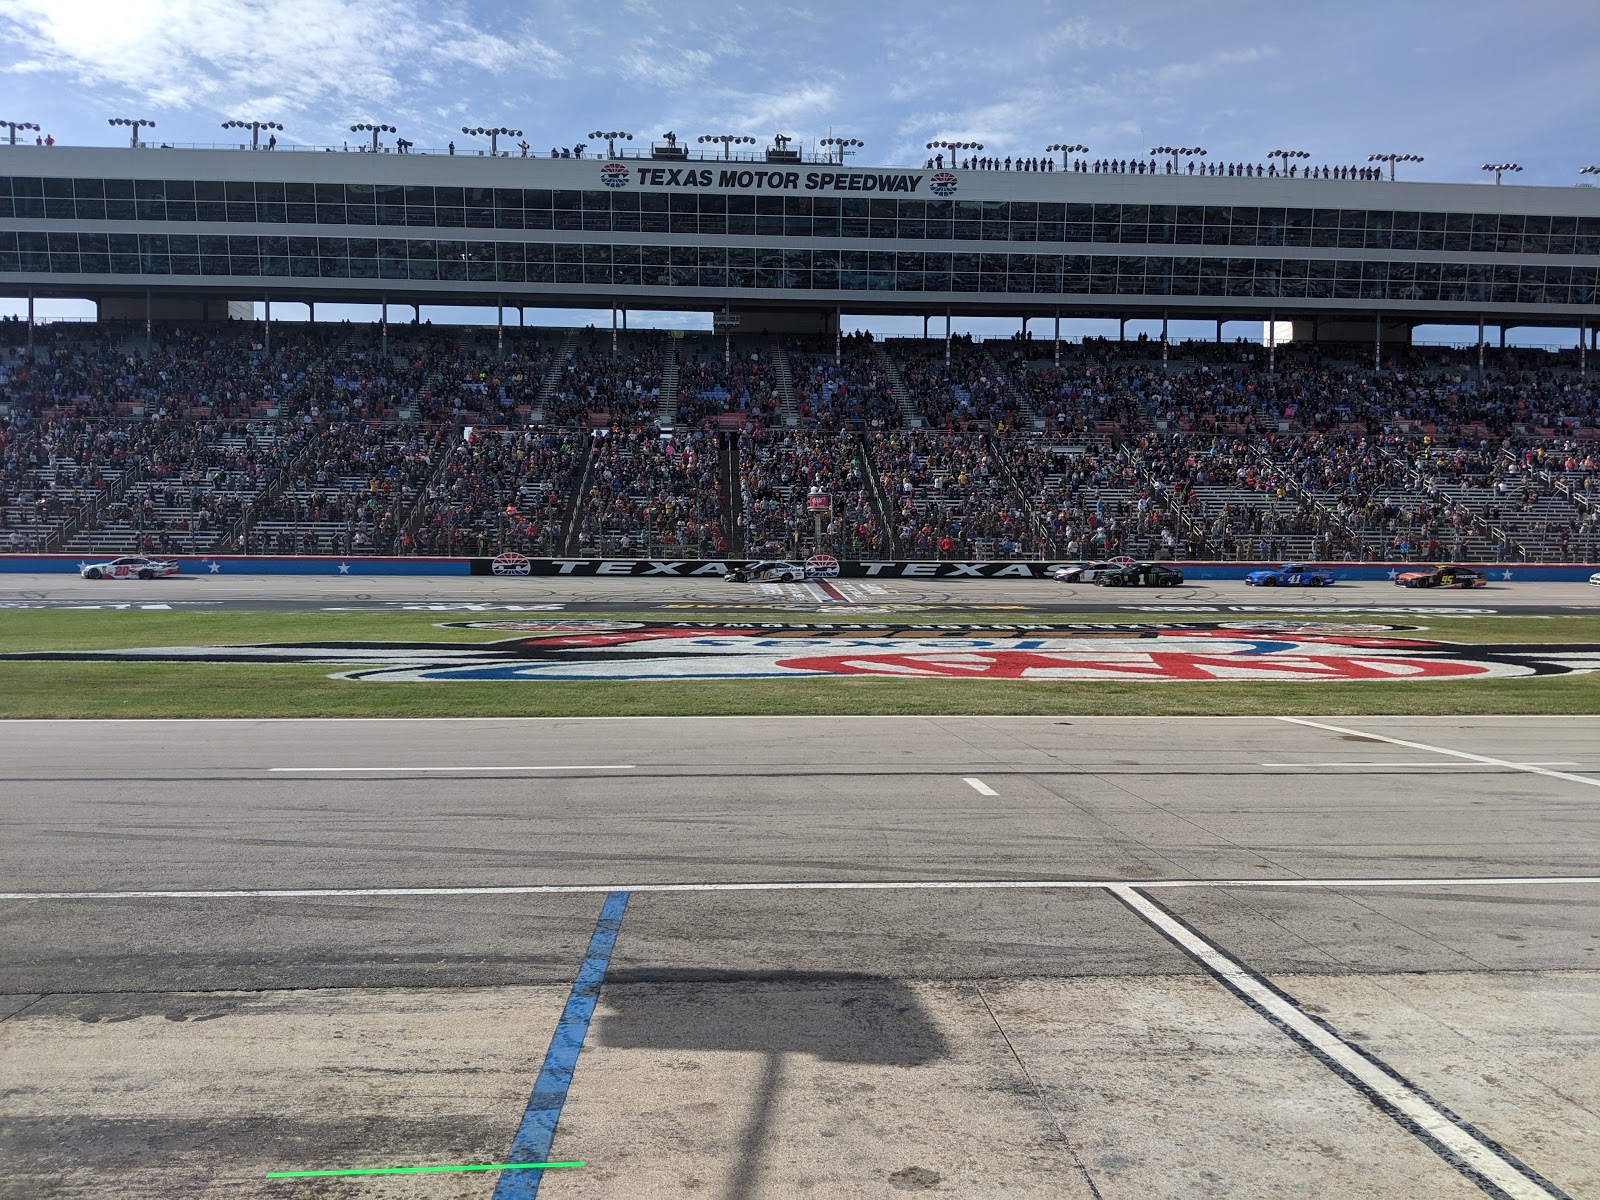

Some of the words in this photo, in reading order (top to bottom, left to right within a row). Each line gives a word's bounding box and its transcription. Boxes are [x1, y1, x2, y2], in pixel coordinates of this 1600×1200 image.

[636, 168, 713, 188] TEXAS
[718, 170, 800, 190] MOTOR
[804, 173, 924, 193] SPEEDWAY
[114, 565, 130, 576] 20
[551, 561, 759, 575] TEXA
[760, 570, 772, 579] 10
[1138, 573, 1146, 585] 1
[1287, 574, 1302, 584] 41
[1440, 575, 1453, 585] 95
